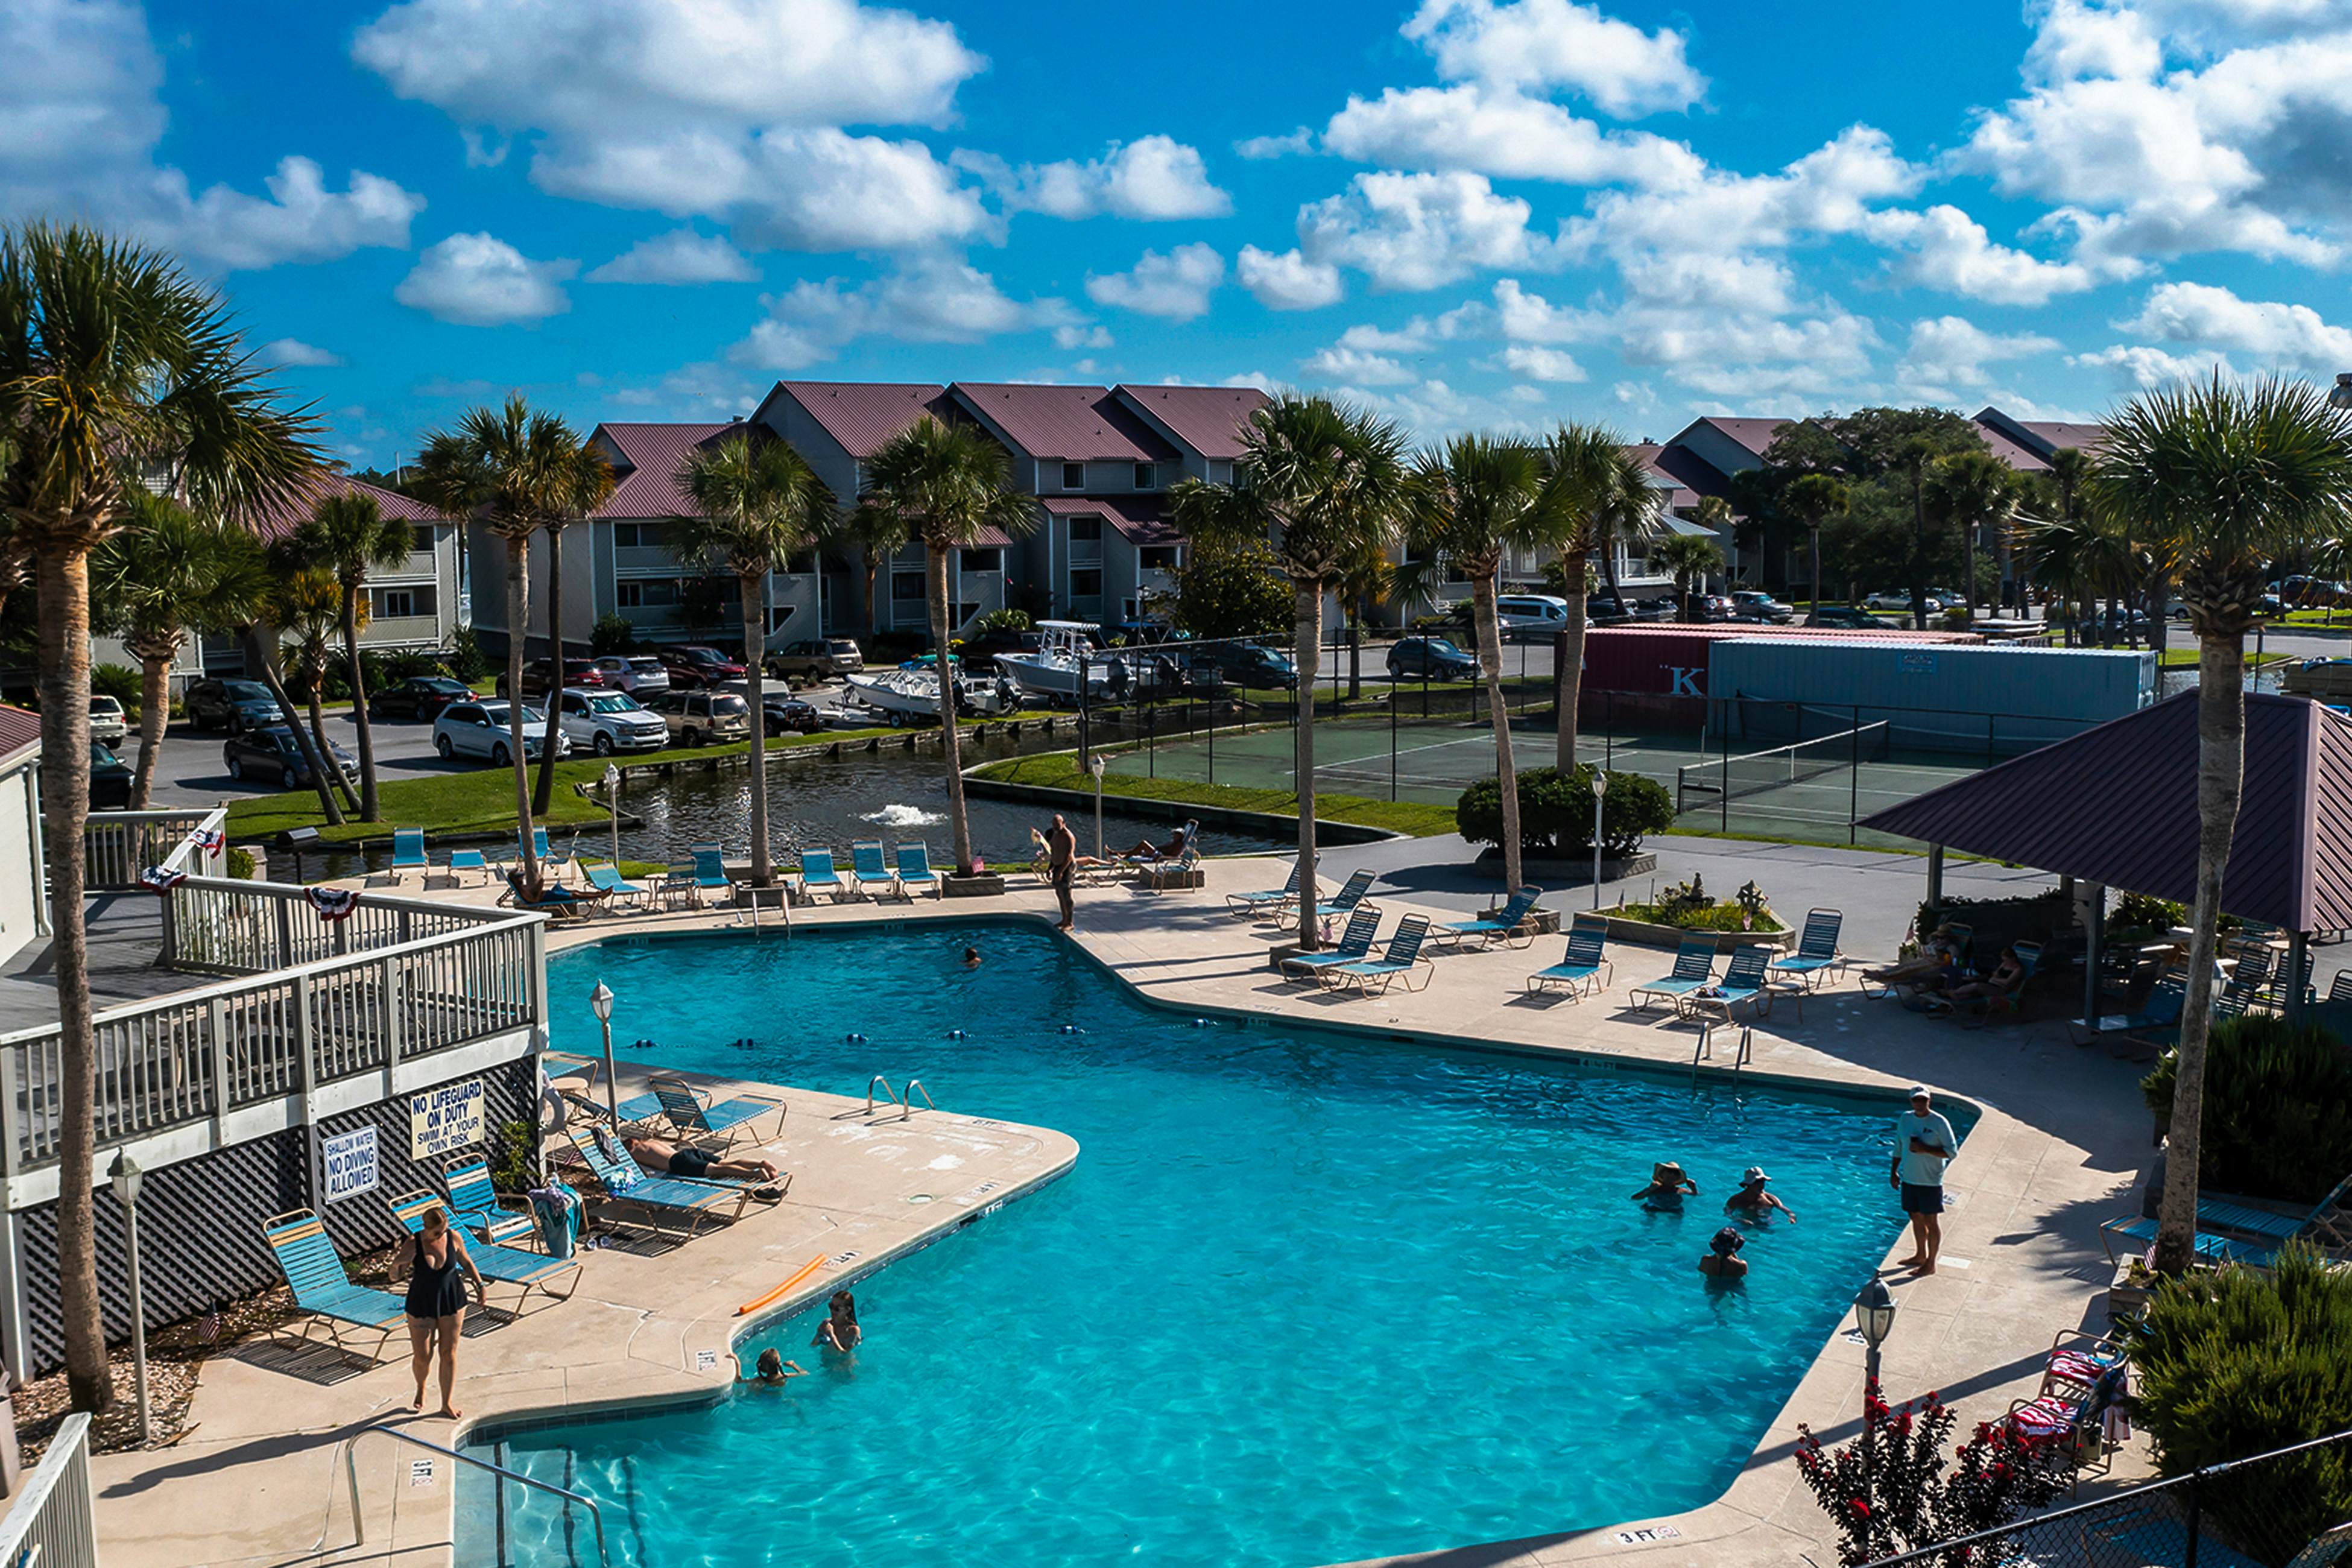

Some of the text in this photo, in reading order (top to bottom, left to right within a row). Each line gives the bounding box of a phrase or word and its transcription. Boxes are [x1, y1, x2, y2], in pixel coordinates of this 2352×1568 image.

[413, 1081, 481, 1115] NO LIFEGUARD
[427, 1102, 468, 1128] ON DUTY
[327, 1131, 373, 1156] SHALLOW WATER
[417, 1116, 479, 1145] SWIM AT YOUR
[427, 1131, 470, 1154] OWN RISK
[329, 1146, 374, 1176] NO DIVING
[330, 1166, 374, 1195] ALLOWED
[413, 1468, 432, 1476] FT
[1620, 1532, 1633, 1543] 3
[1634, 1529, 1656, 1541] FT
